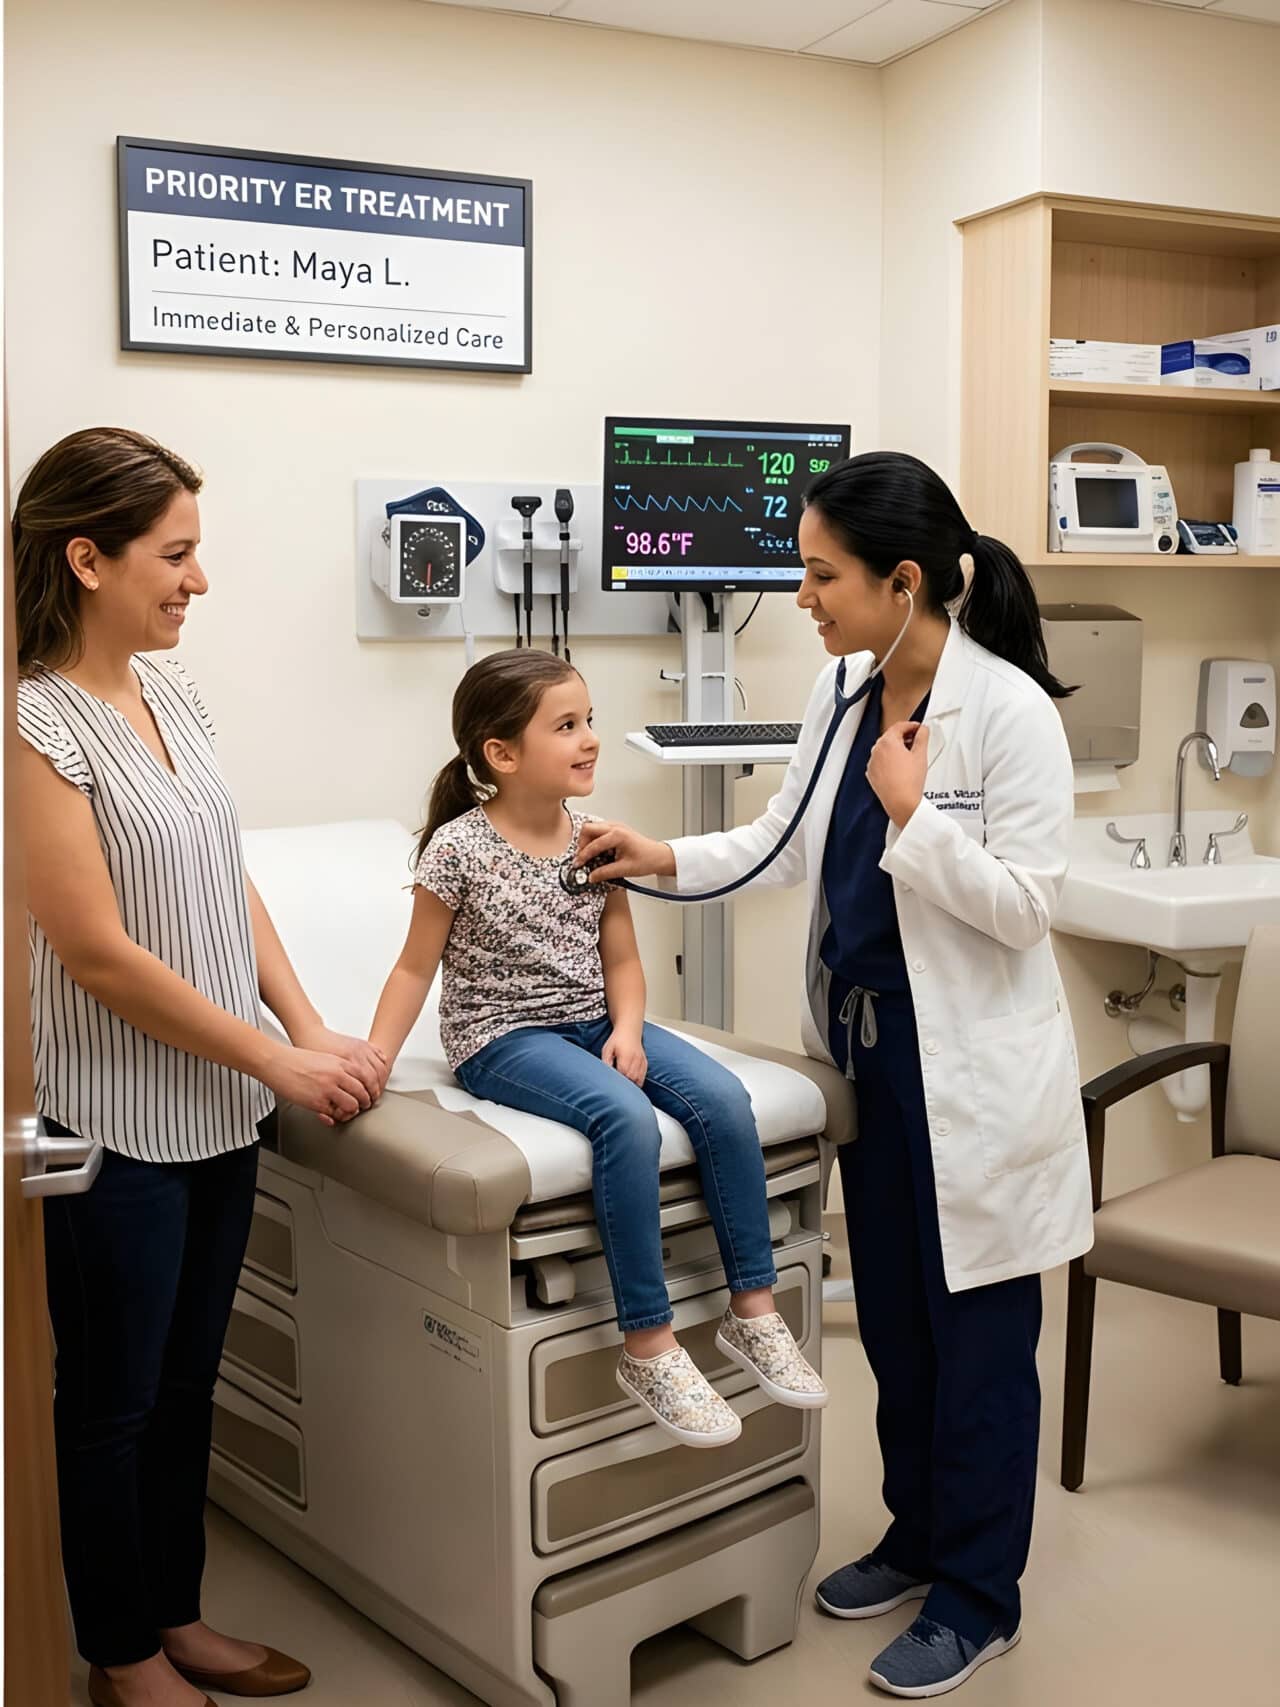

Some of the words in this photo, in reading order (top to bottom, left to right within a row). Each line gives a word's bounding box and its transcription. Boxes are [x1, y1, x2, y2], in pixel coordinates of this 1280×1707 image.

[145, 167, 286, 206] PRIORITY
[295, 182, 332, 211] ER
[340, 186, 510, 228] TREATMENT
[152, 238, 280, 277] Patient:
[292, 250, 373, 289] Maya
[385, 257, 410, 287] L.
[153, 305, 277, 335] Immediate
[284, 315, 301, 336] &
[309, 317, 449, 346] Personalized
[456, 327, 504, 350] Care
[757, 451, 796, 475] 120
[762, 495, 788, 518] 72
